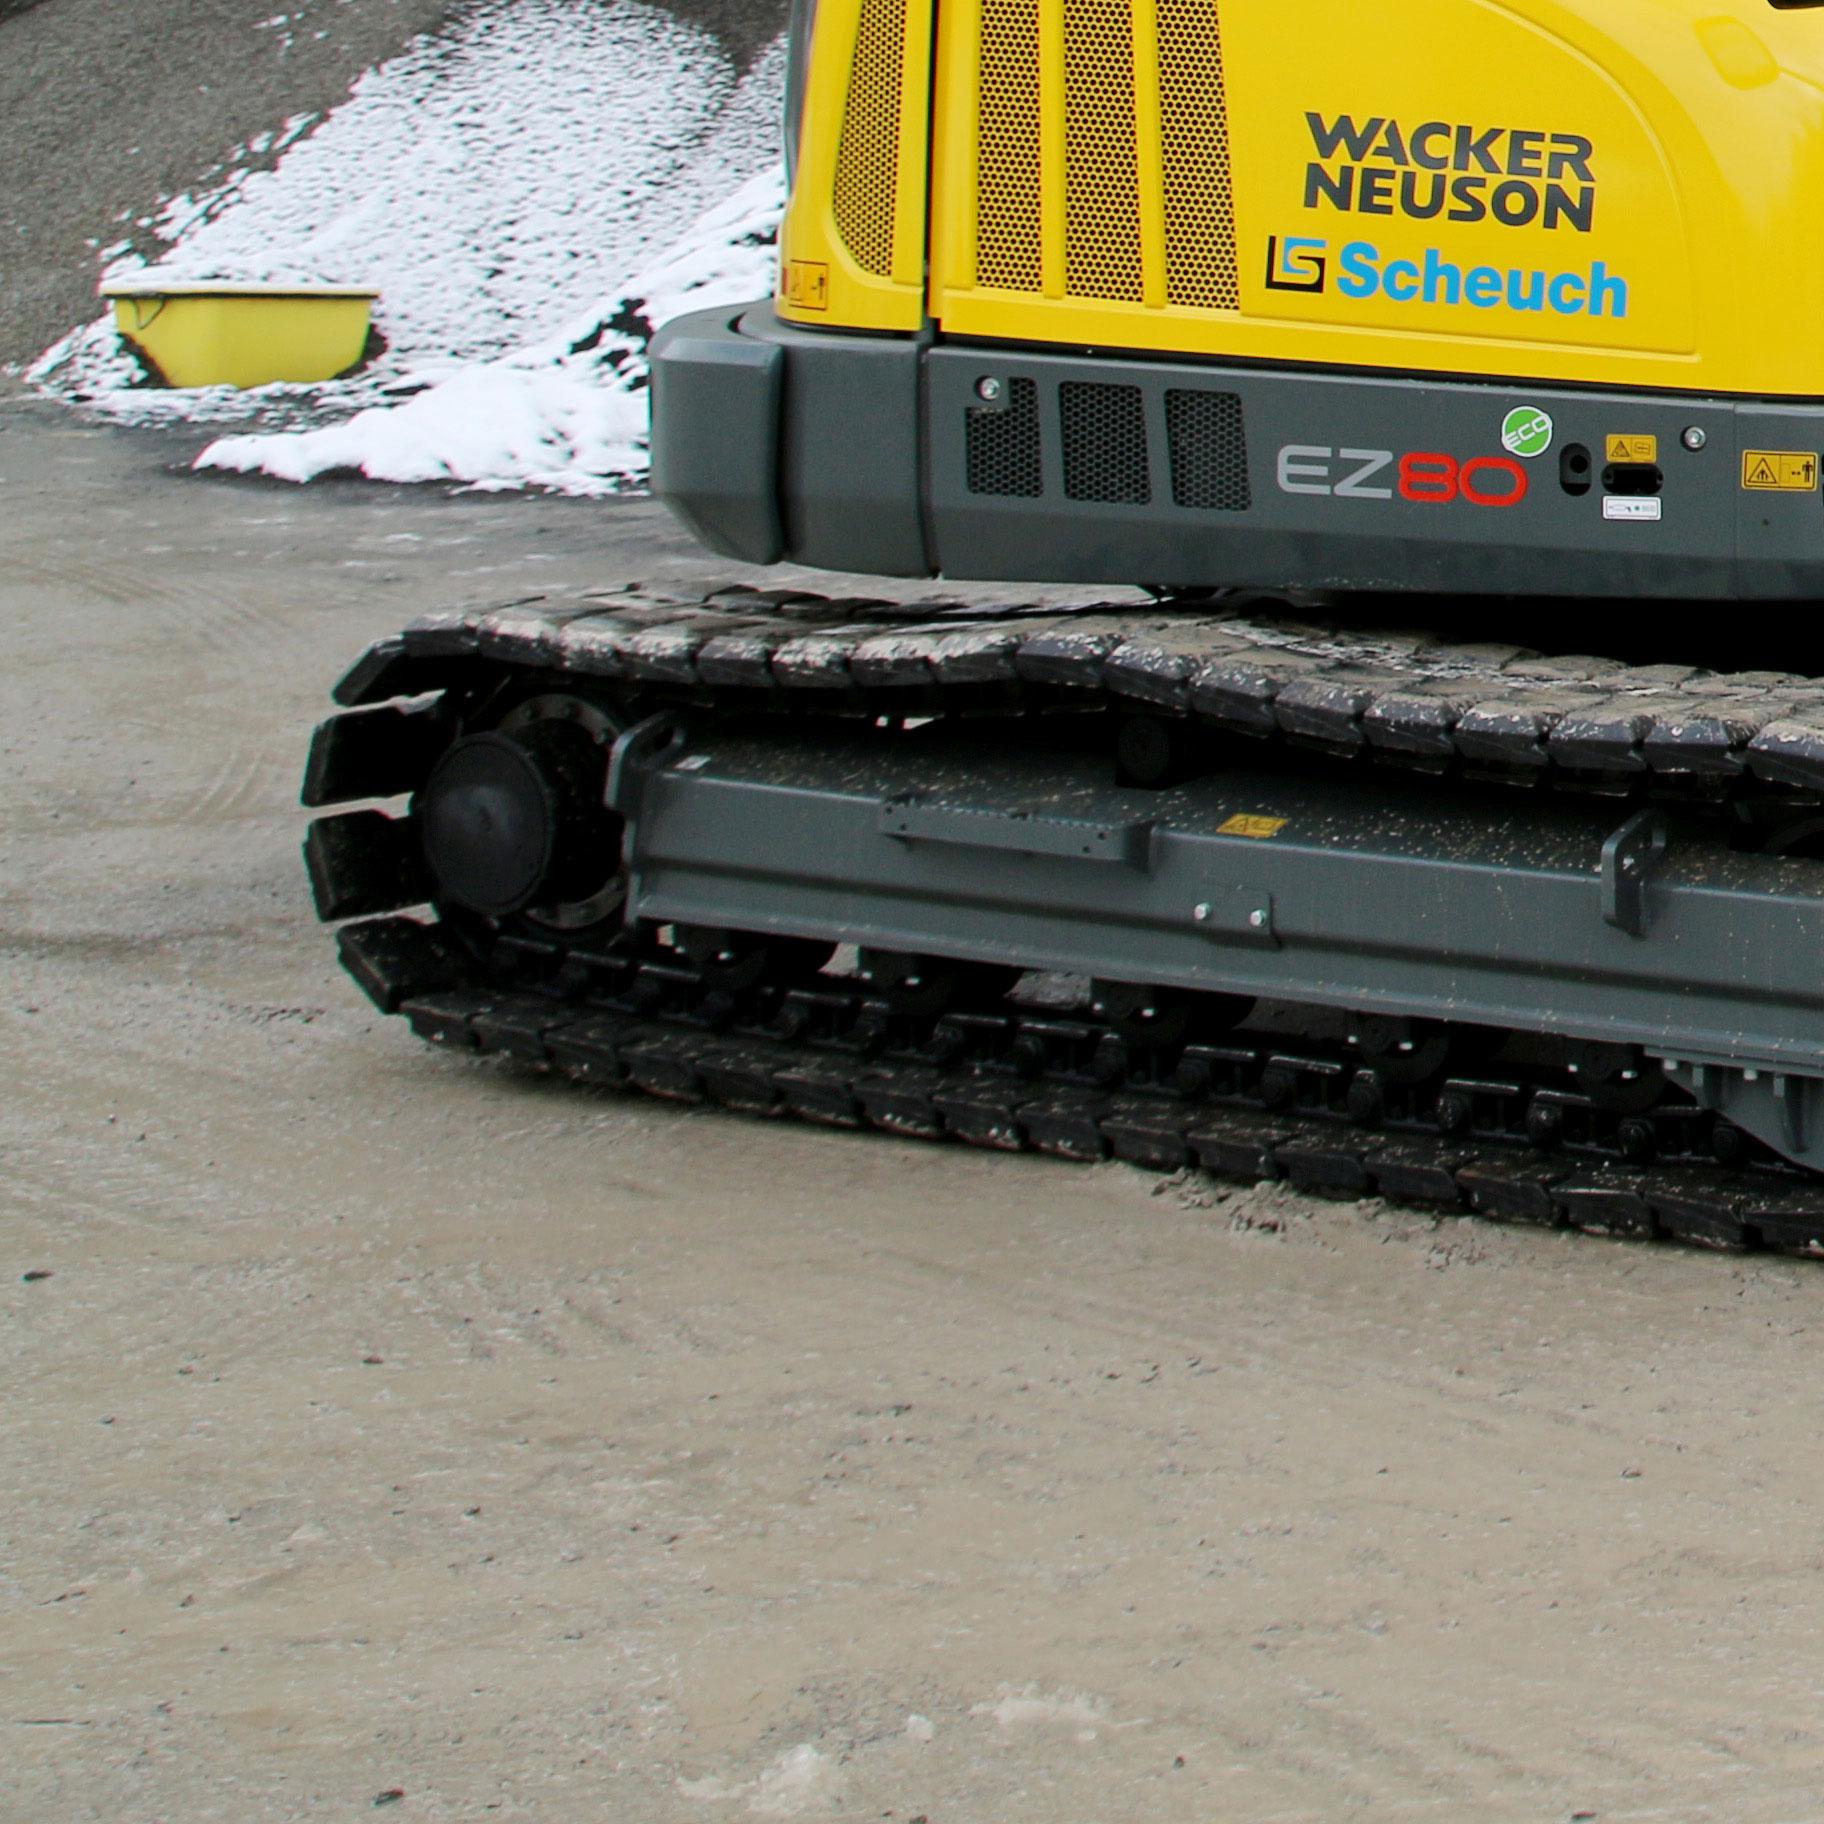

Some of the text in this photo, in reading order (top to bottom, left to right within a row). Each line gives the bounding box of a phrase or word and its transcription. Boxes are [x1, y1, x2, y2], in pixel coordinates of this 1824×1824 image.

[1305, 111, 1596, 182] WACKER
[1303, 162, 1595, 233] NEUSON
[1337, 241, 1629, 318] Scheuch
[1502, 413, 1553, 449] ECO
[1277, 444, 1529, 507] EZ80
